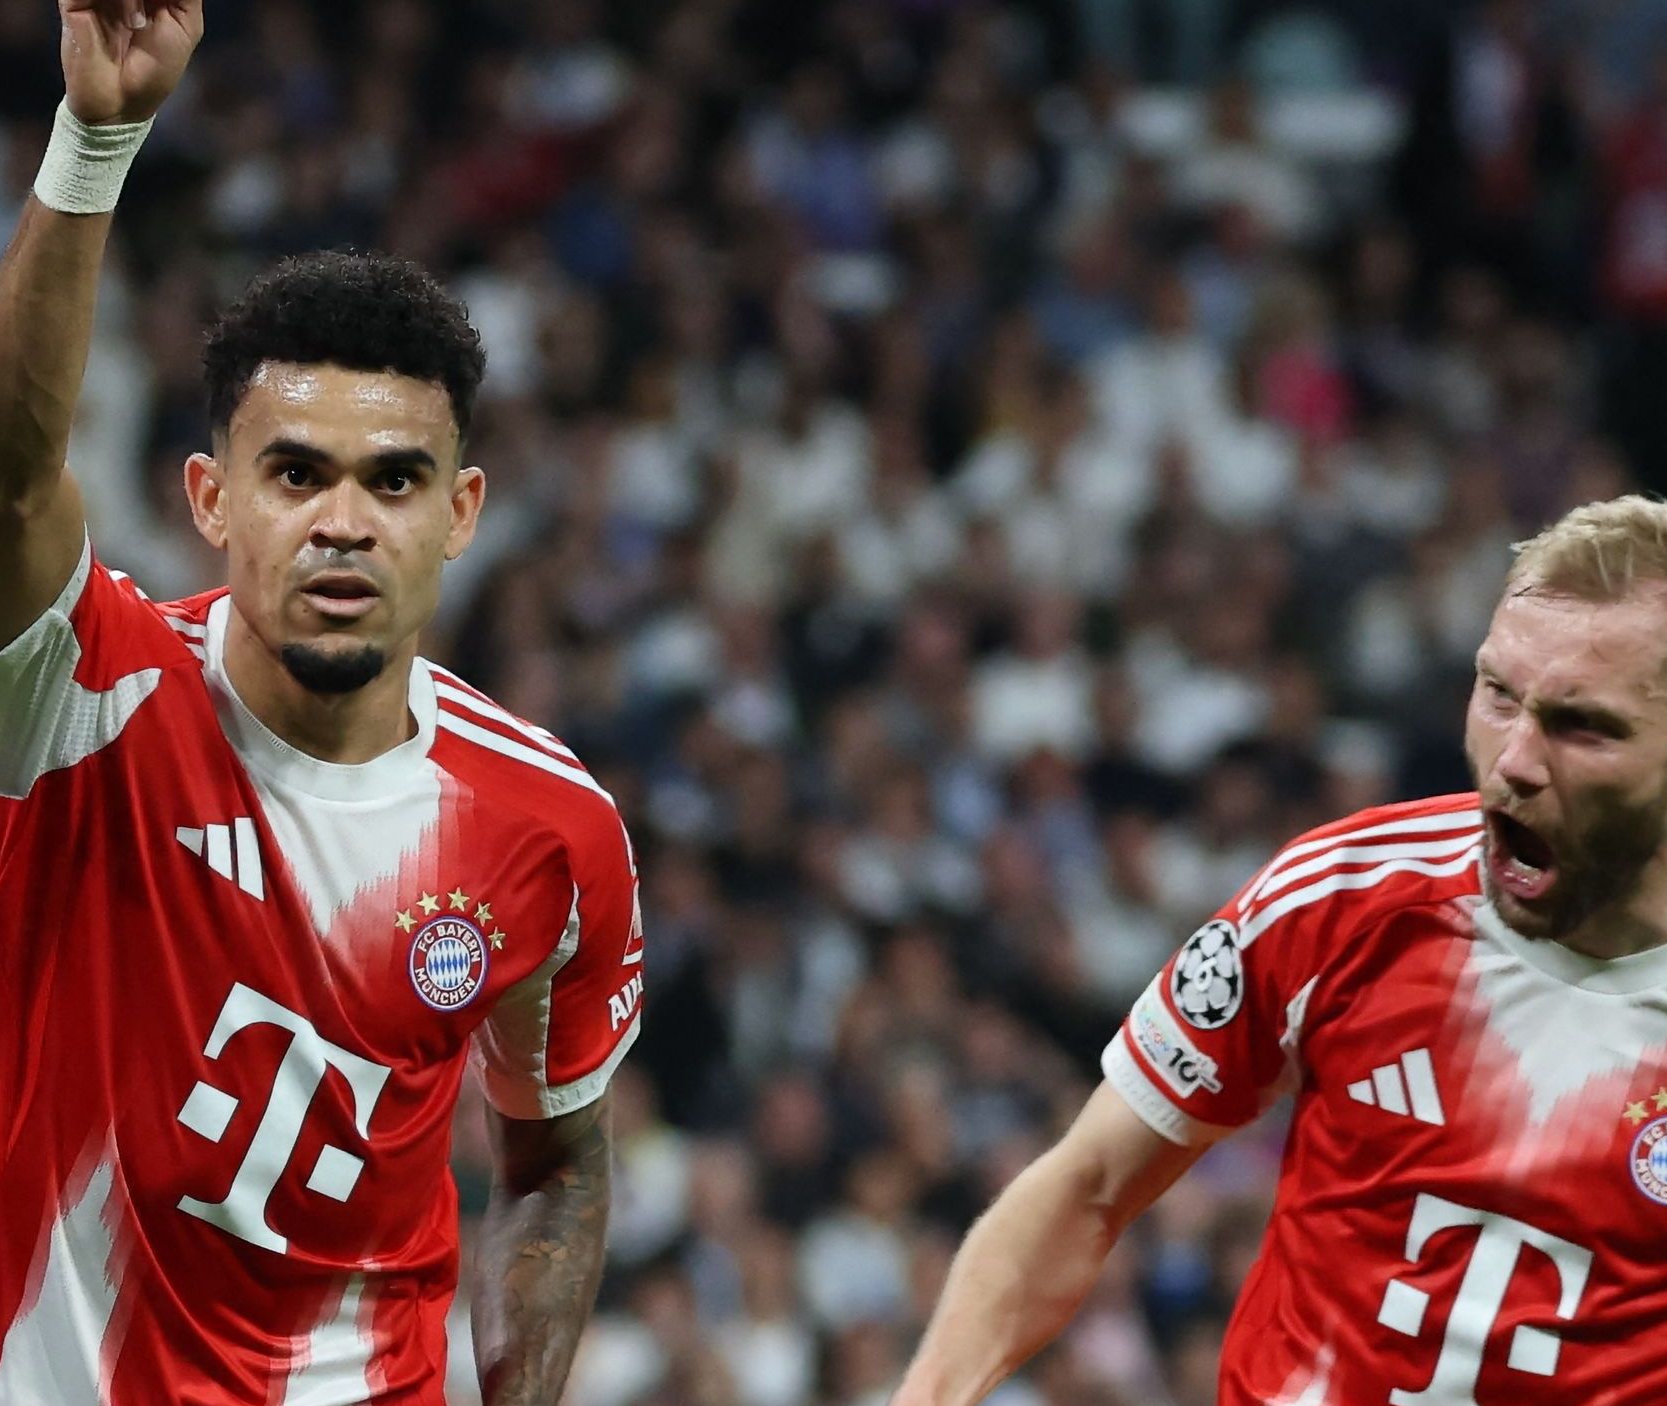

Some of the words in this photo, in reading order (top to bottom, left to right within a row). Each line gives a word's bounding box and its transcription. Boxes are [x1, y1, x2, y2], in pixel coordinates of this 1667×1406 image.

[417, 931, 435, 952] FC
[436, 923, 481, 963] BAYERN
[1193, 956, 1218, 992] 6
[177, 981, 392, 1254] T
